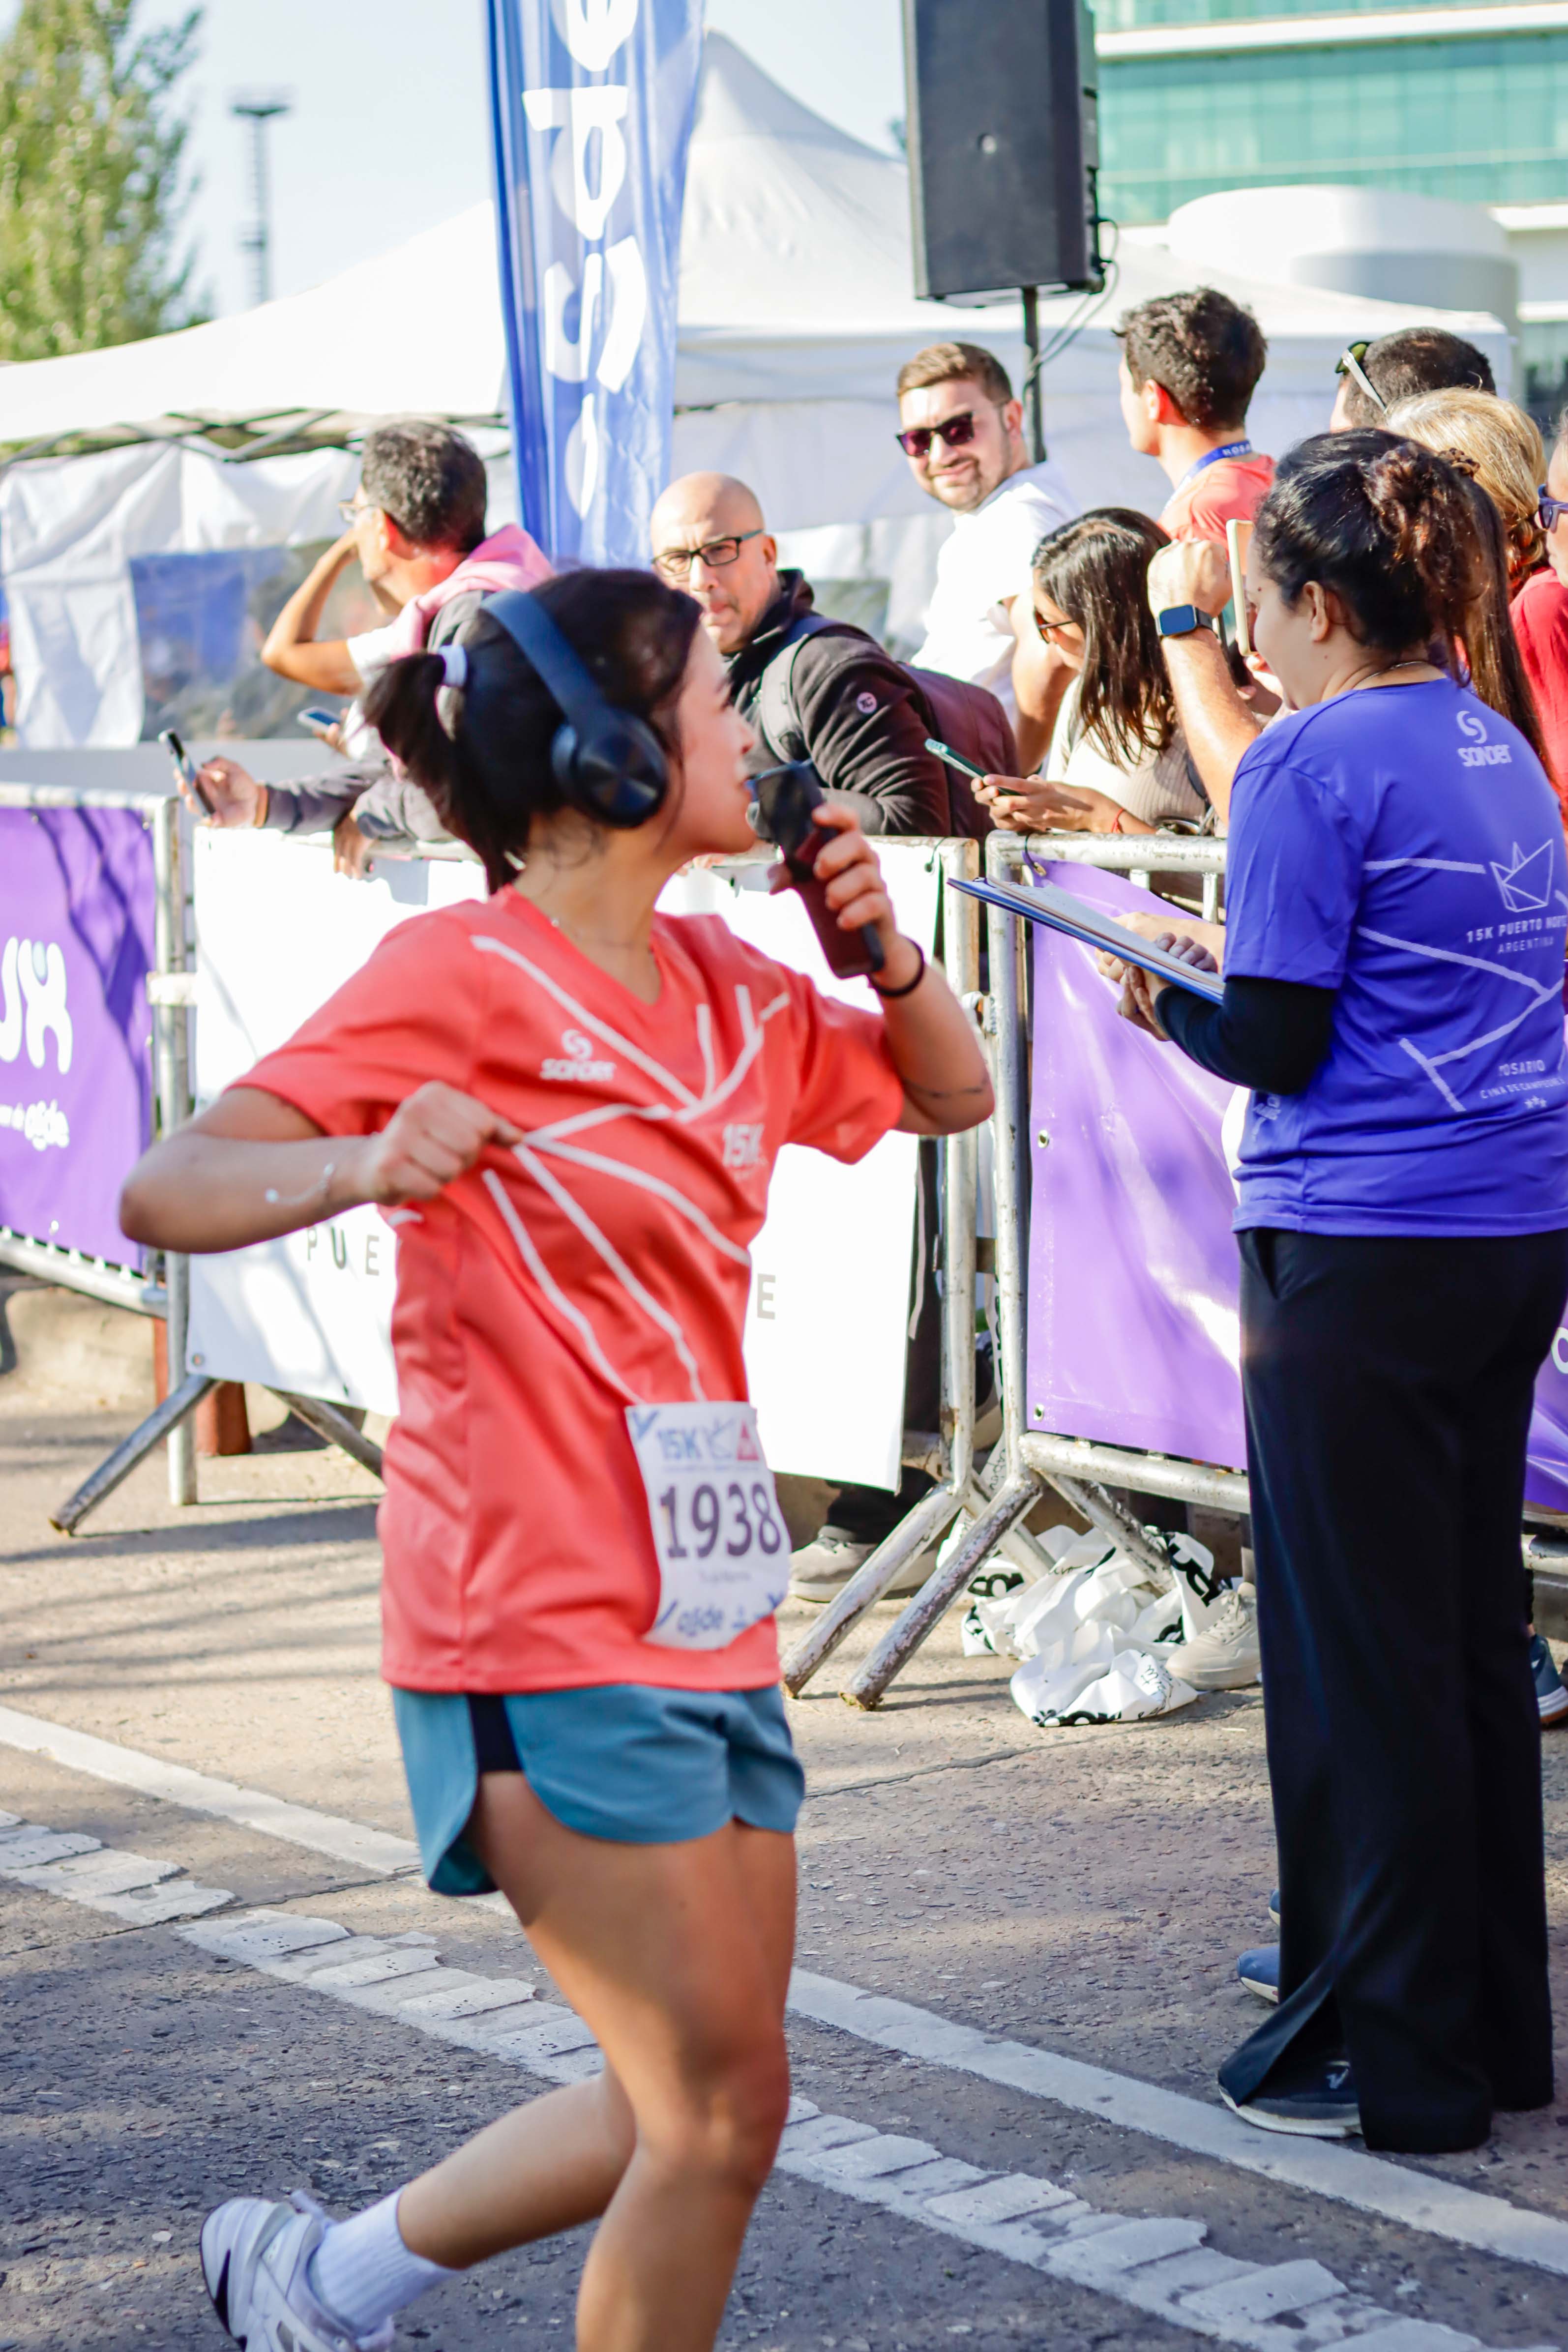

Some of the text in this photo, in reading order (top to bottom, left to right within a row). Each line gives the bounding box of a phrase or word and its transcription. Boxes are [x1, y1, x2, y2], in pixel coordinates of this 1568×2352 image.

[1466, 926, 1494, 943] 15K
[1498, 918, 1543, 937] PUERTO
[660, 1483, 781, 1558] 1938
